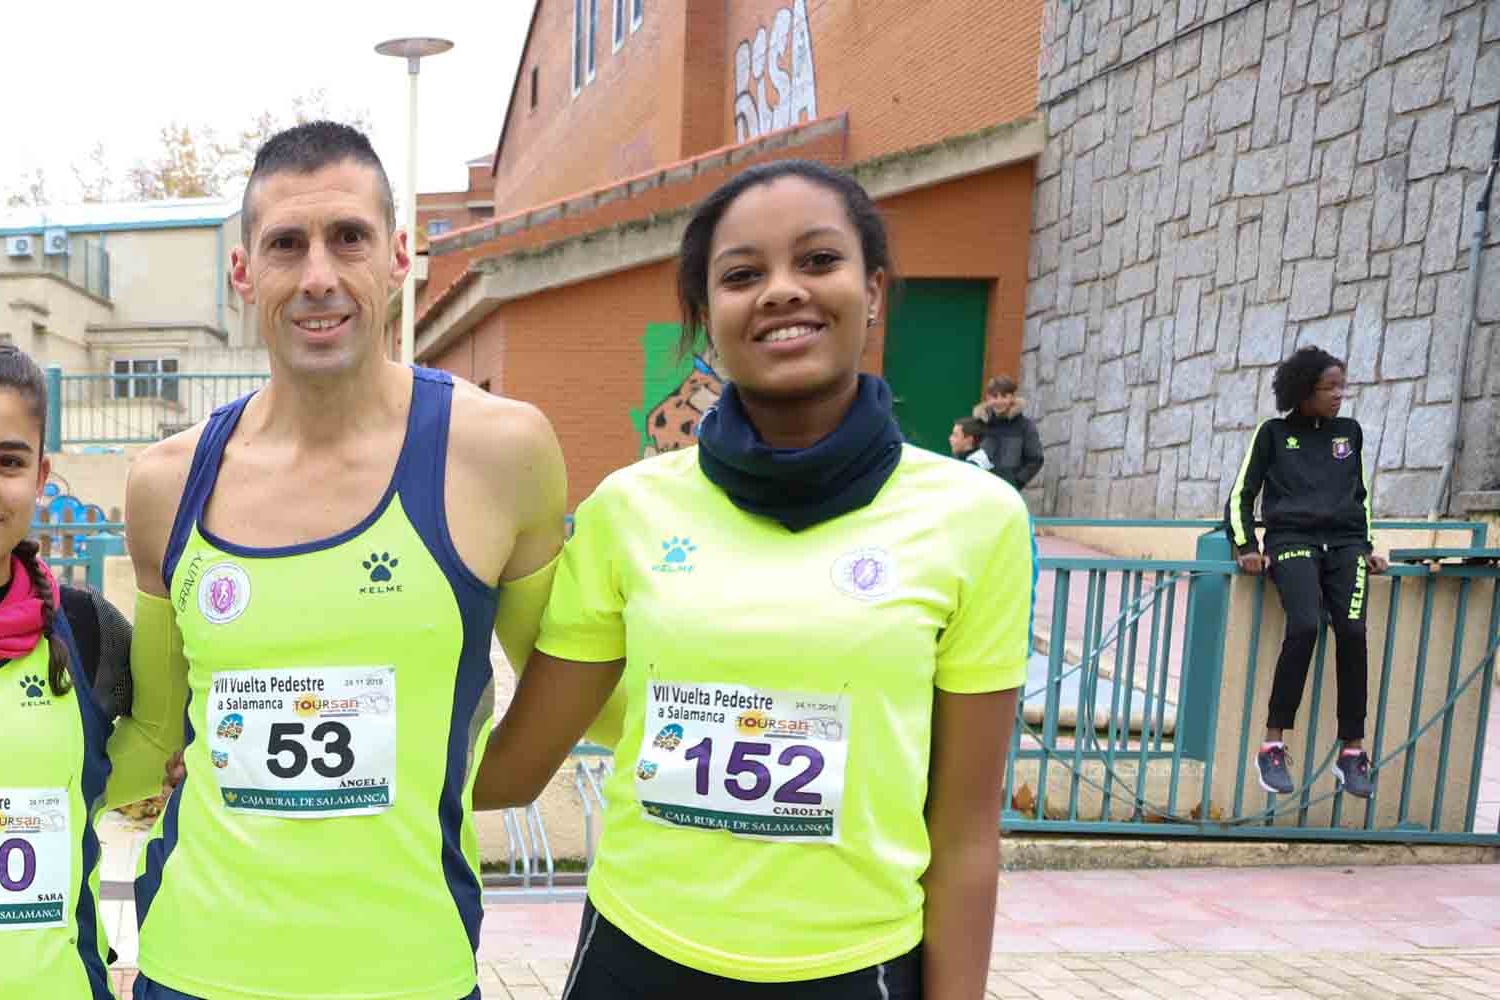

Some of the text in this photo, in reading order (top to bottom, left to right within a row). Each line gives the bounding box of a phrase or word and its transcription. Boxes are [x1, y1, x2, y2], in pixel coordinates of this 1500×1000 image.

[359, 584, 403, 593] KELME
[214, 675, 324, 694] VII Vuelta Pedestre
[217, 698, 283, 710] a Salamanca
[653, 685, 773, 710] VII Vuelta Pedestre
[658, 706, 725, 723] a Salamanca
[266, 721, 355, 779] 53
[685, 737, 825, 805] 152
[241, 793, 387, 806] CAJA RURAL DE SALAMANCA
[773, 806, 834, 816] CAROLYN
[665, 811, 831, 833] CAJA RURAL DE SALAMANCA
[37, 893, 63, 901] SARA
[0, 909, 61, 920] SALAMANCA
